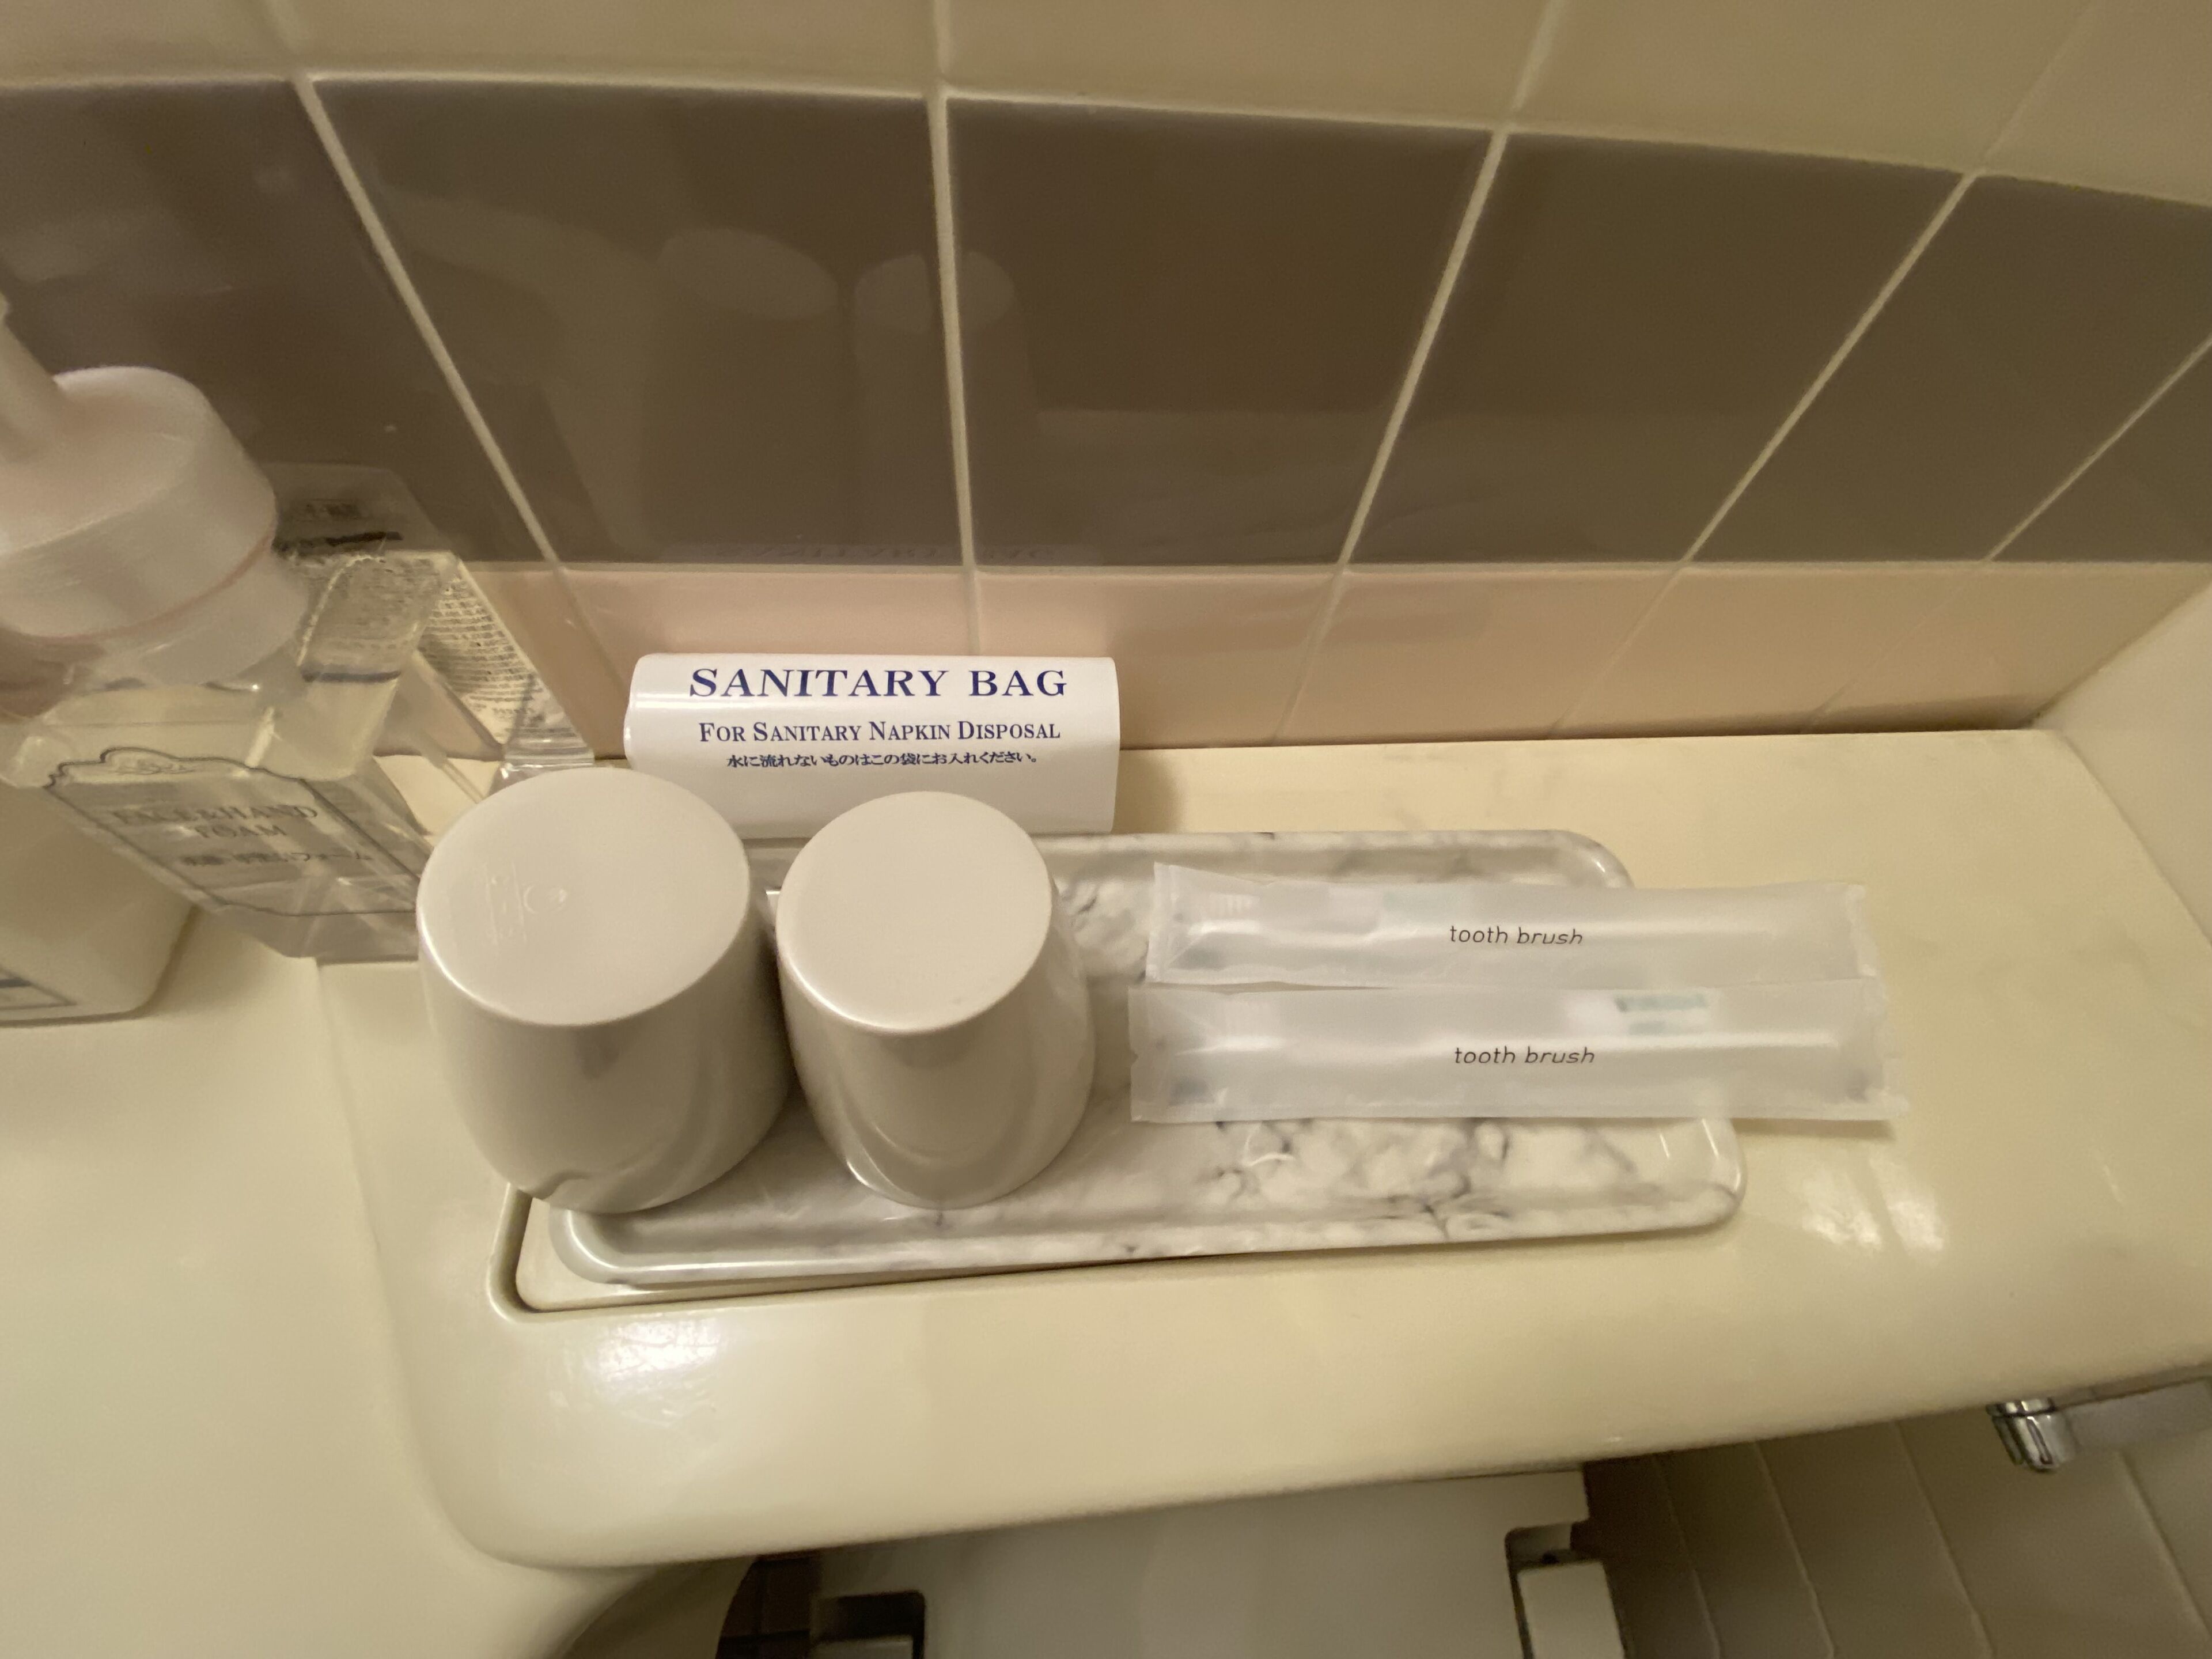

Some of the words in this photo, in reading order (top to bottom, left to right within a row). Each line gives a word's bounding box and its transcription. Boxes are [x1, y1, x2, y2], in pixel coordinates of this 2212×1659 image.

[690, 668, 950, 698] SANITARY
[968, 669, 1068, 697] BAG
[698, 722, 747, 743] FOR
[753, 721, 862, 742] SANITARY
[868, 721, 951, 741] NAPKIN
[957, 720, 1061, 740] DISPOSAL
[726, 751, 1037, 768] 水に流れないものはこの袋にお入れください。
[1449, 925, 1509, 944] tooth
[1516, 926, 1584, 945] brush
[1455, 1046, 1516, 1064] tooth
[1524, 1046, 1596, 1064] brush
